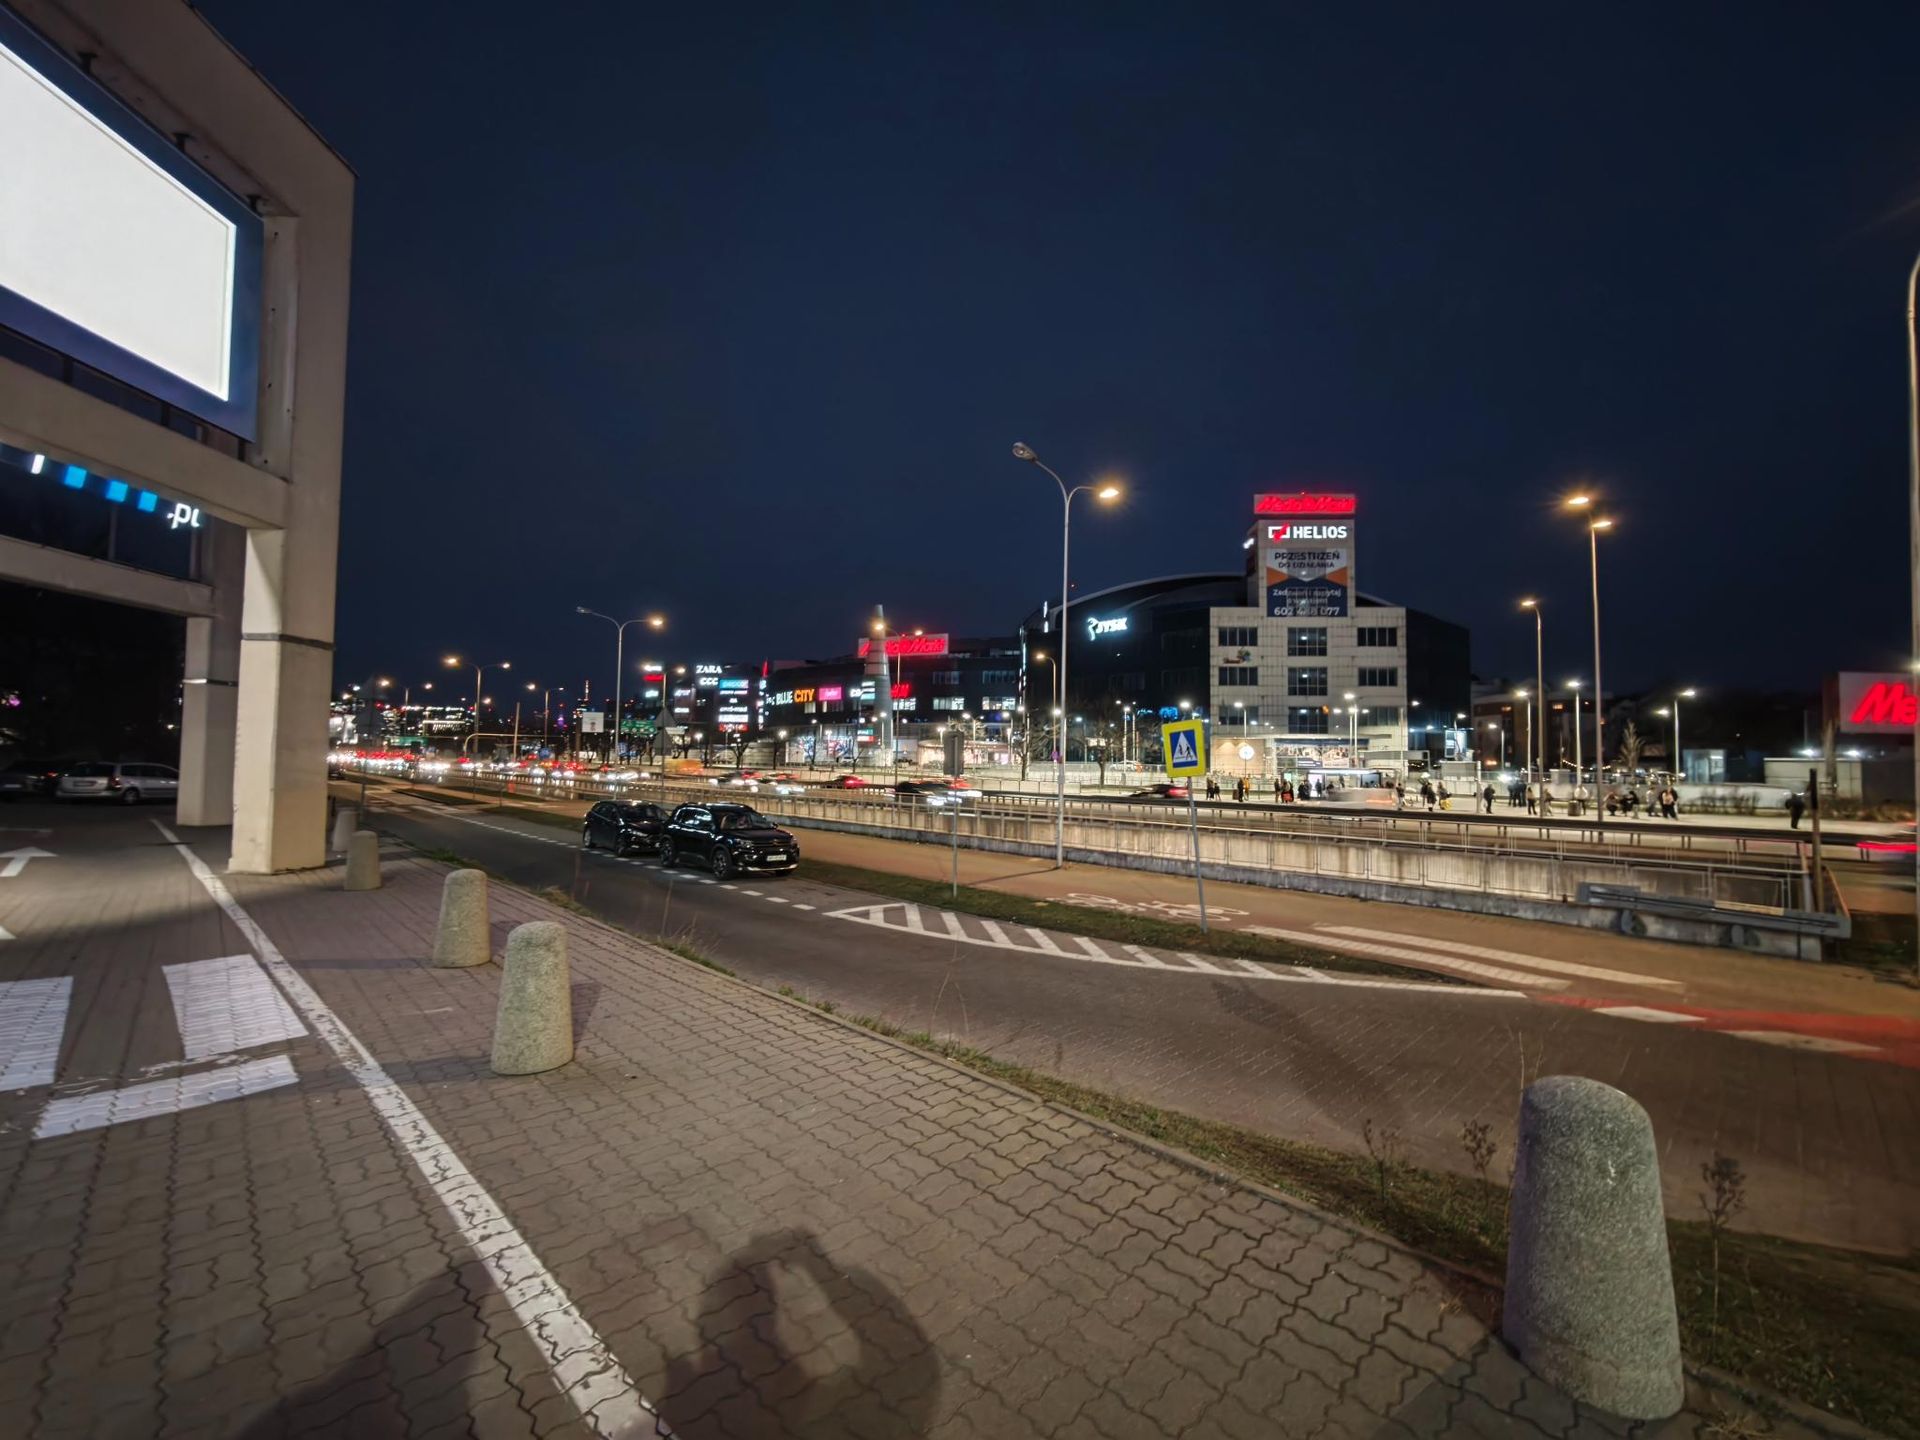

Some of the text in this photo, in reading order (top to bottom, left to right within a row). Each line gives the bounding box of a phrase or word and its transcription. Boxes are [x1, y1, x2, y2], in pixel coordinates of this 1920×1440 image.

[167, 502, 201, 530] .pl
[1292, 525, 1348, 539] HELIOS
[1273, 606, 1294, 616] 602
[1320, 606, 1341, 616] 077
[696, 664, 722, 674] ZARA
[700, 677, 719, 686] CCC
[775, 690, 794, 706] BLUE
[794, 688, 815, 703] CITY
